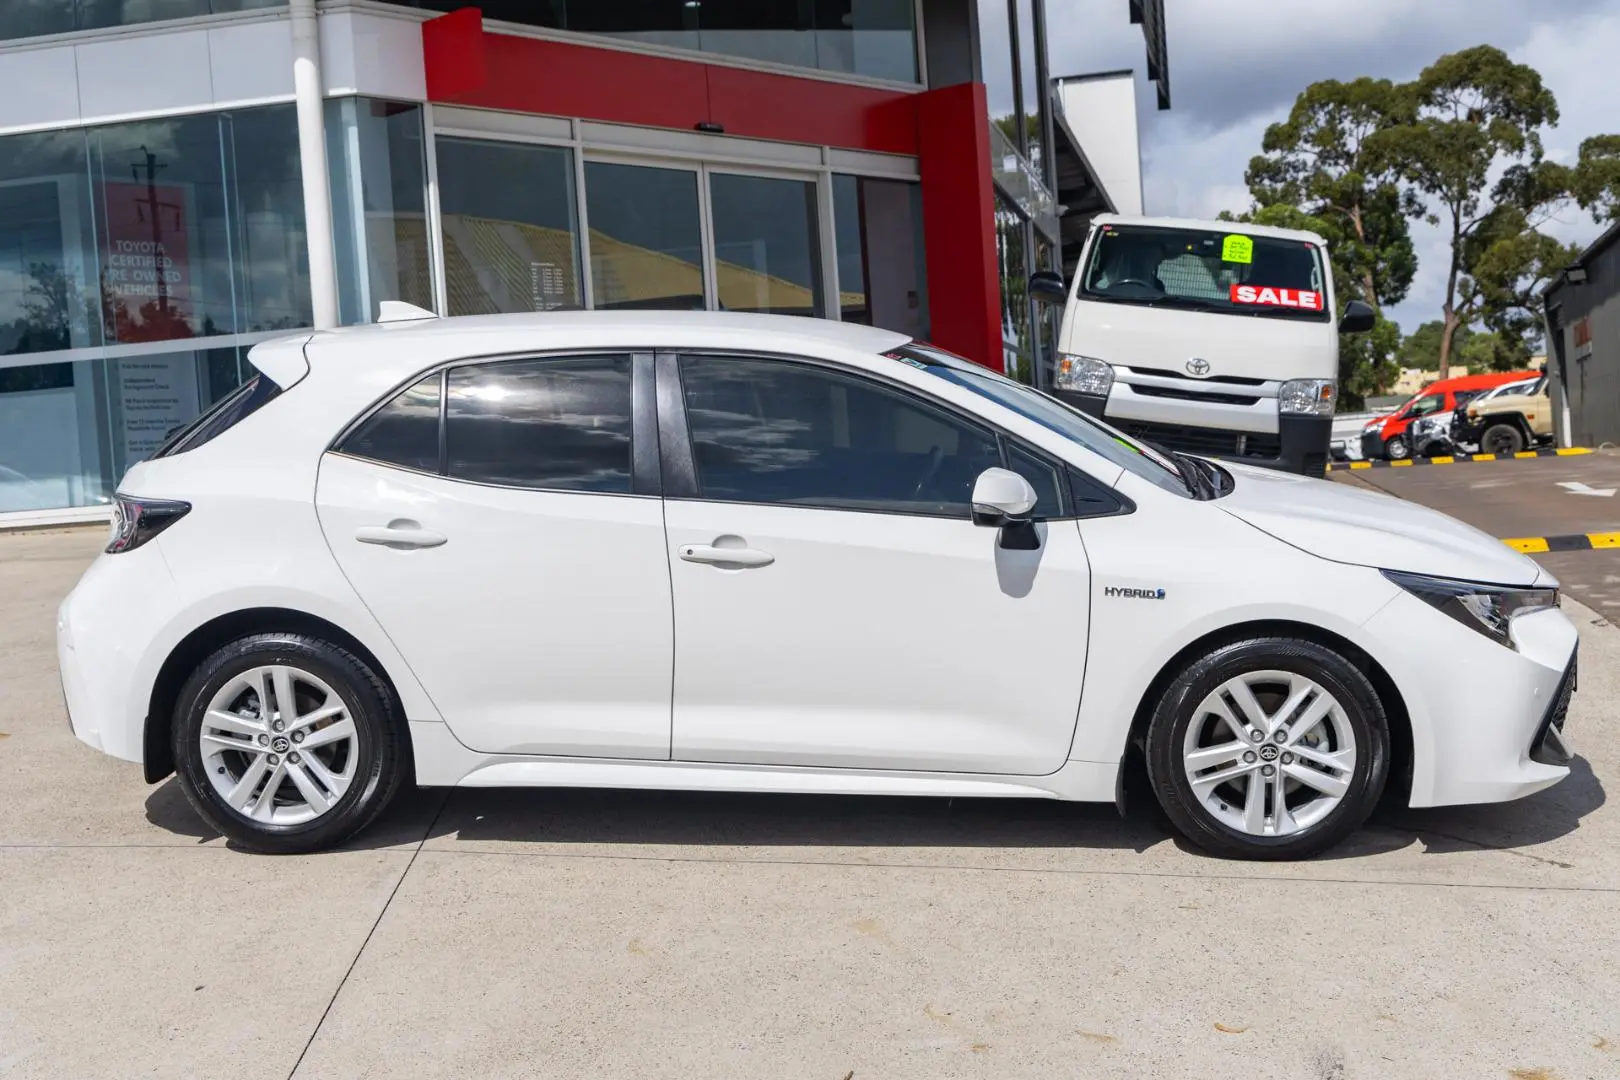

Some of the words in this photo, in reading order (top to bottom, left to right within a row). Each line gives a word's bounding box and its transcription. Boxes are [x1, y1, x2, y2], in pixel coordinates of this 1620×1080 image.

[116, 240, 166, 254] TOYOTA
[111, 254, 173, 269] CERTIFIED
[108, 268, 128, 281] RE
[114, 283, 174, 297] VEHICLES
[1237, 286, 1317, 308] SALE
[1104, 586, 1156, 599] HYBRID
